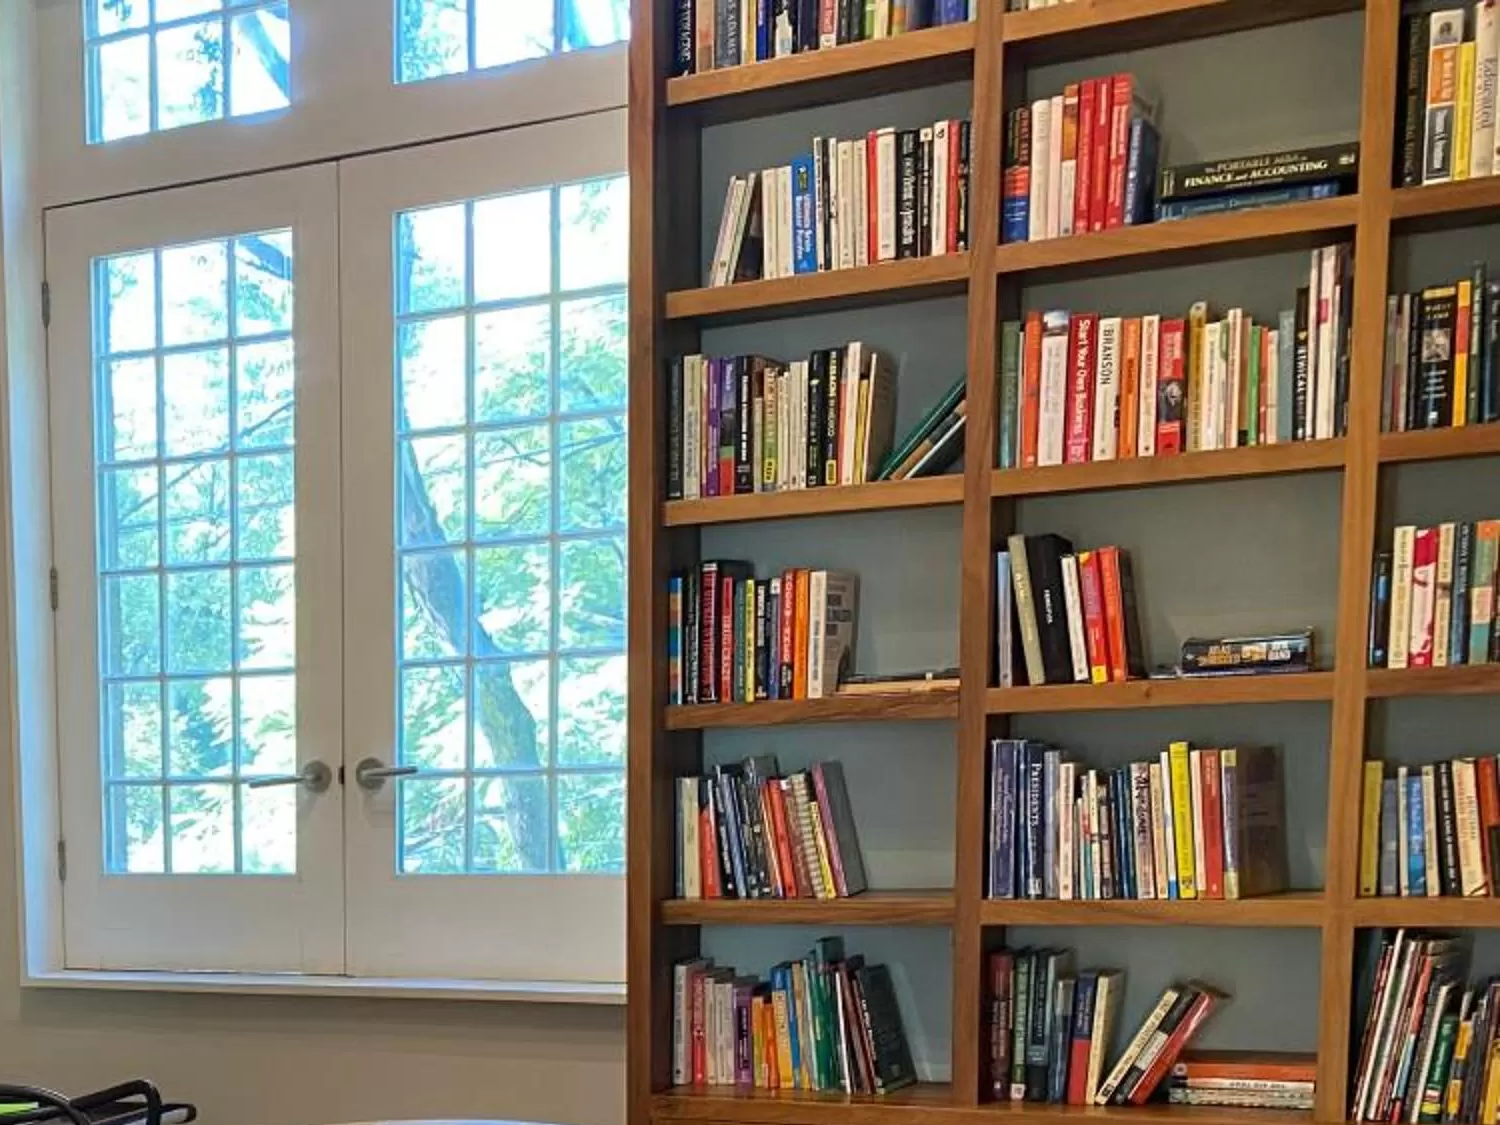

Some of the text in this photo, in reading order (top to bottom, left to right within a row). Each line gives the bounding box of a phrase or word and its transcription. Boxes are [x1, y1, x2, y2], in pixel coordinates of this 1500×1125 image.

[1184, 173, 1232, 188] FINANCE
[1235, 173, 1248, 181] and
[1250, 161, 1328, 178] ACCOUNTING
[1217, 157, 1269, 171] PORTABLE
[1078, 319, 1090, 345] Start
[1077, 345, 1089, 368] Your
[1100, 329, 1114, 385] BRANSON
[1074, 392, 1087, 434] Business
